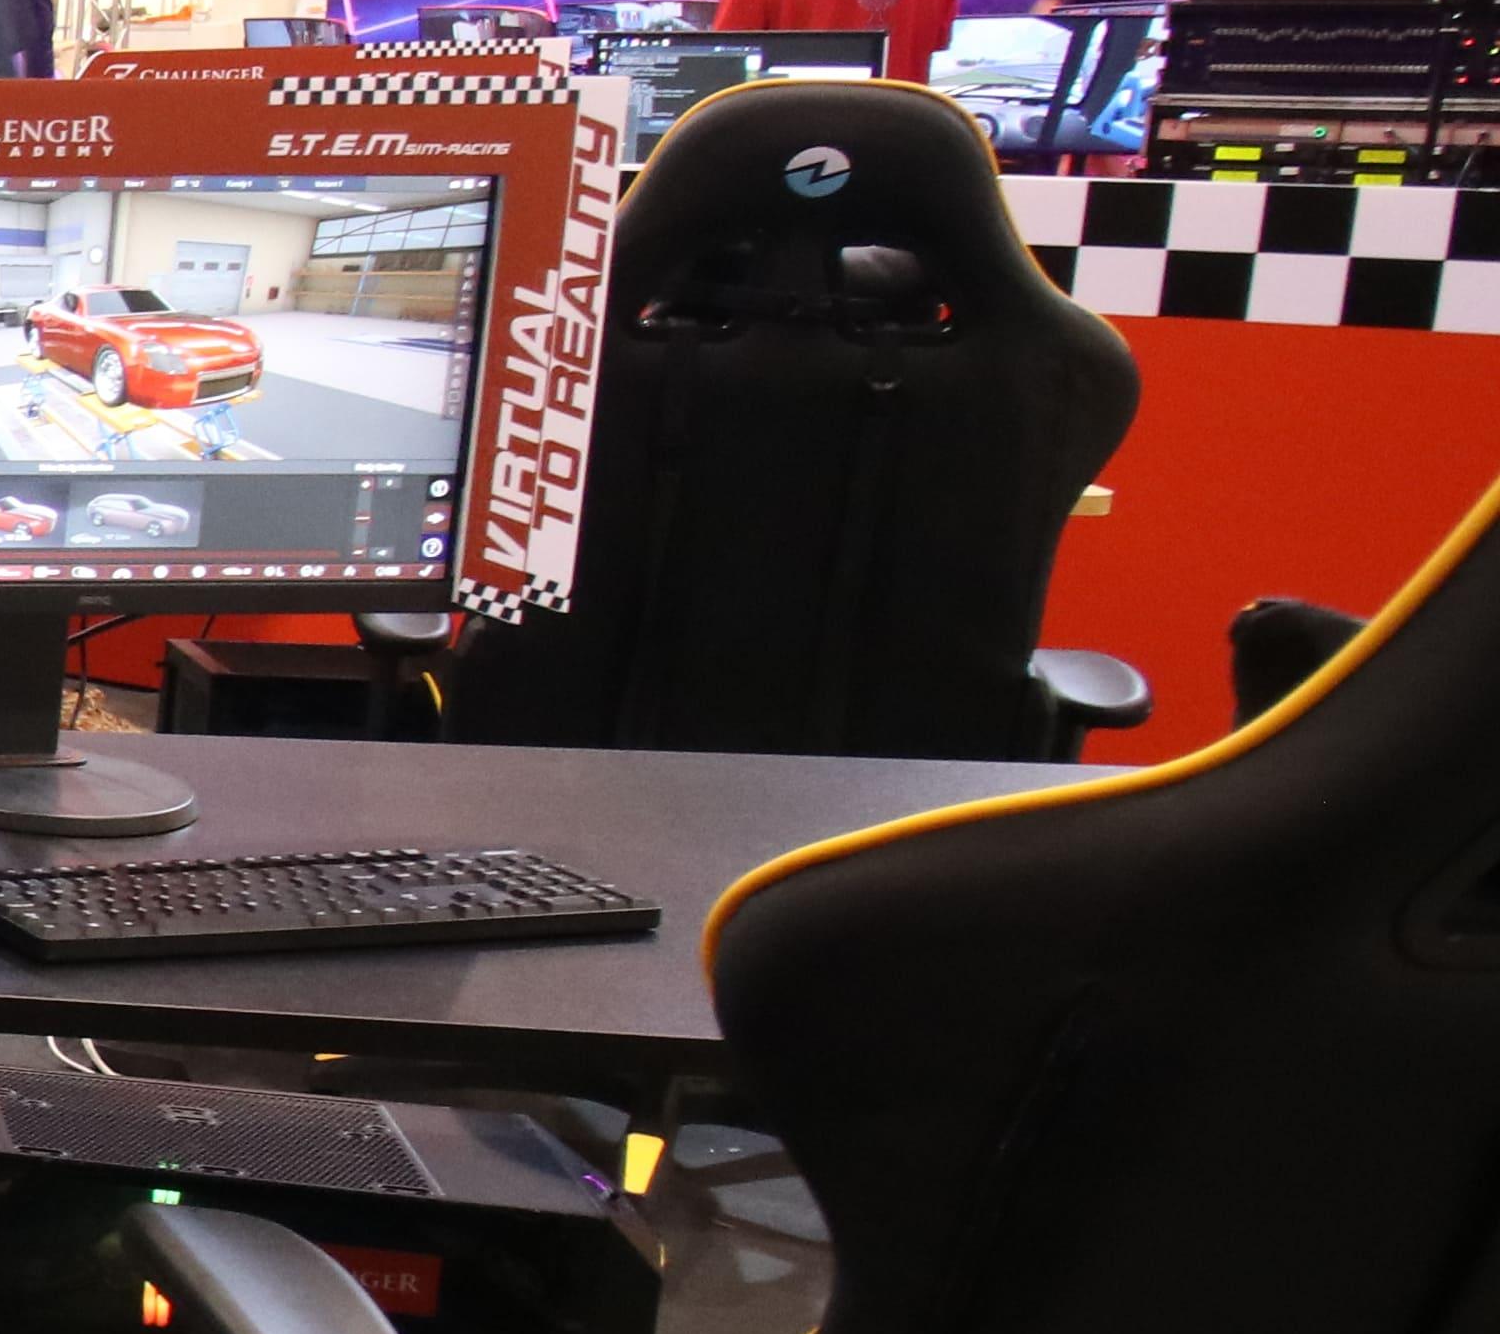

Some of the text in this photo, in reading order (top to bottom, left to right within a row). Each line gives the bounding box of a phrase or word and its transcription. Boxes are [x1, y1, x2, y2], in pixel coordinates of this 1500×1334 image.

[266, 132, 408, 157] S.T.E.M
[547, 114, 619, 421] REALITY
[483, 267, 561, 569] VIRTUAL
[531, 439, 583, 531] TO
